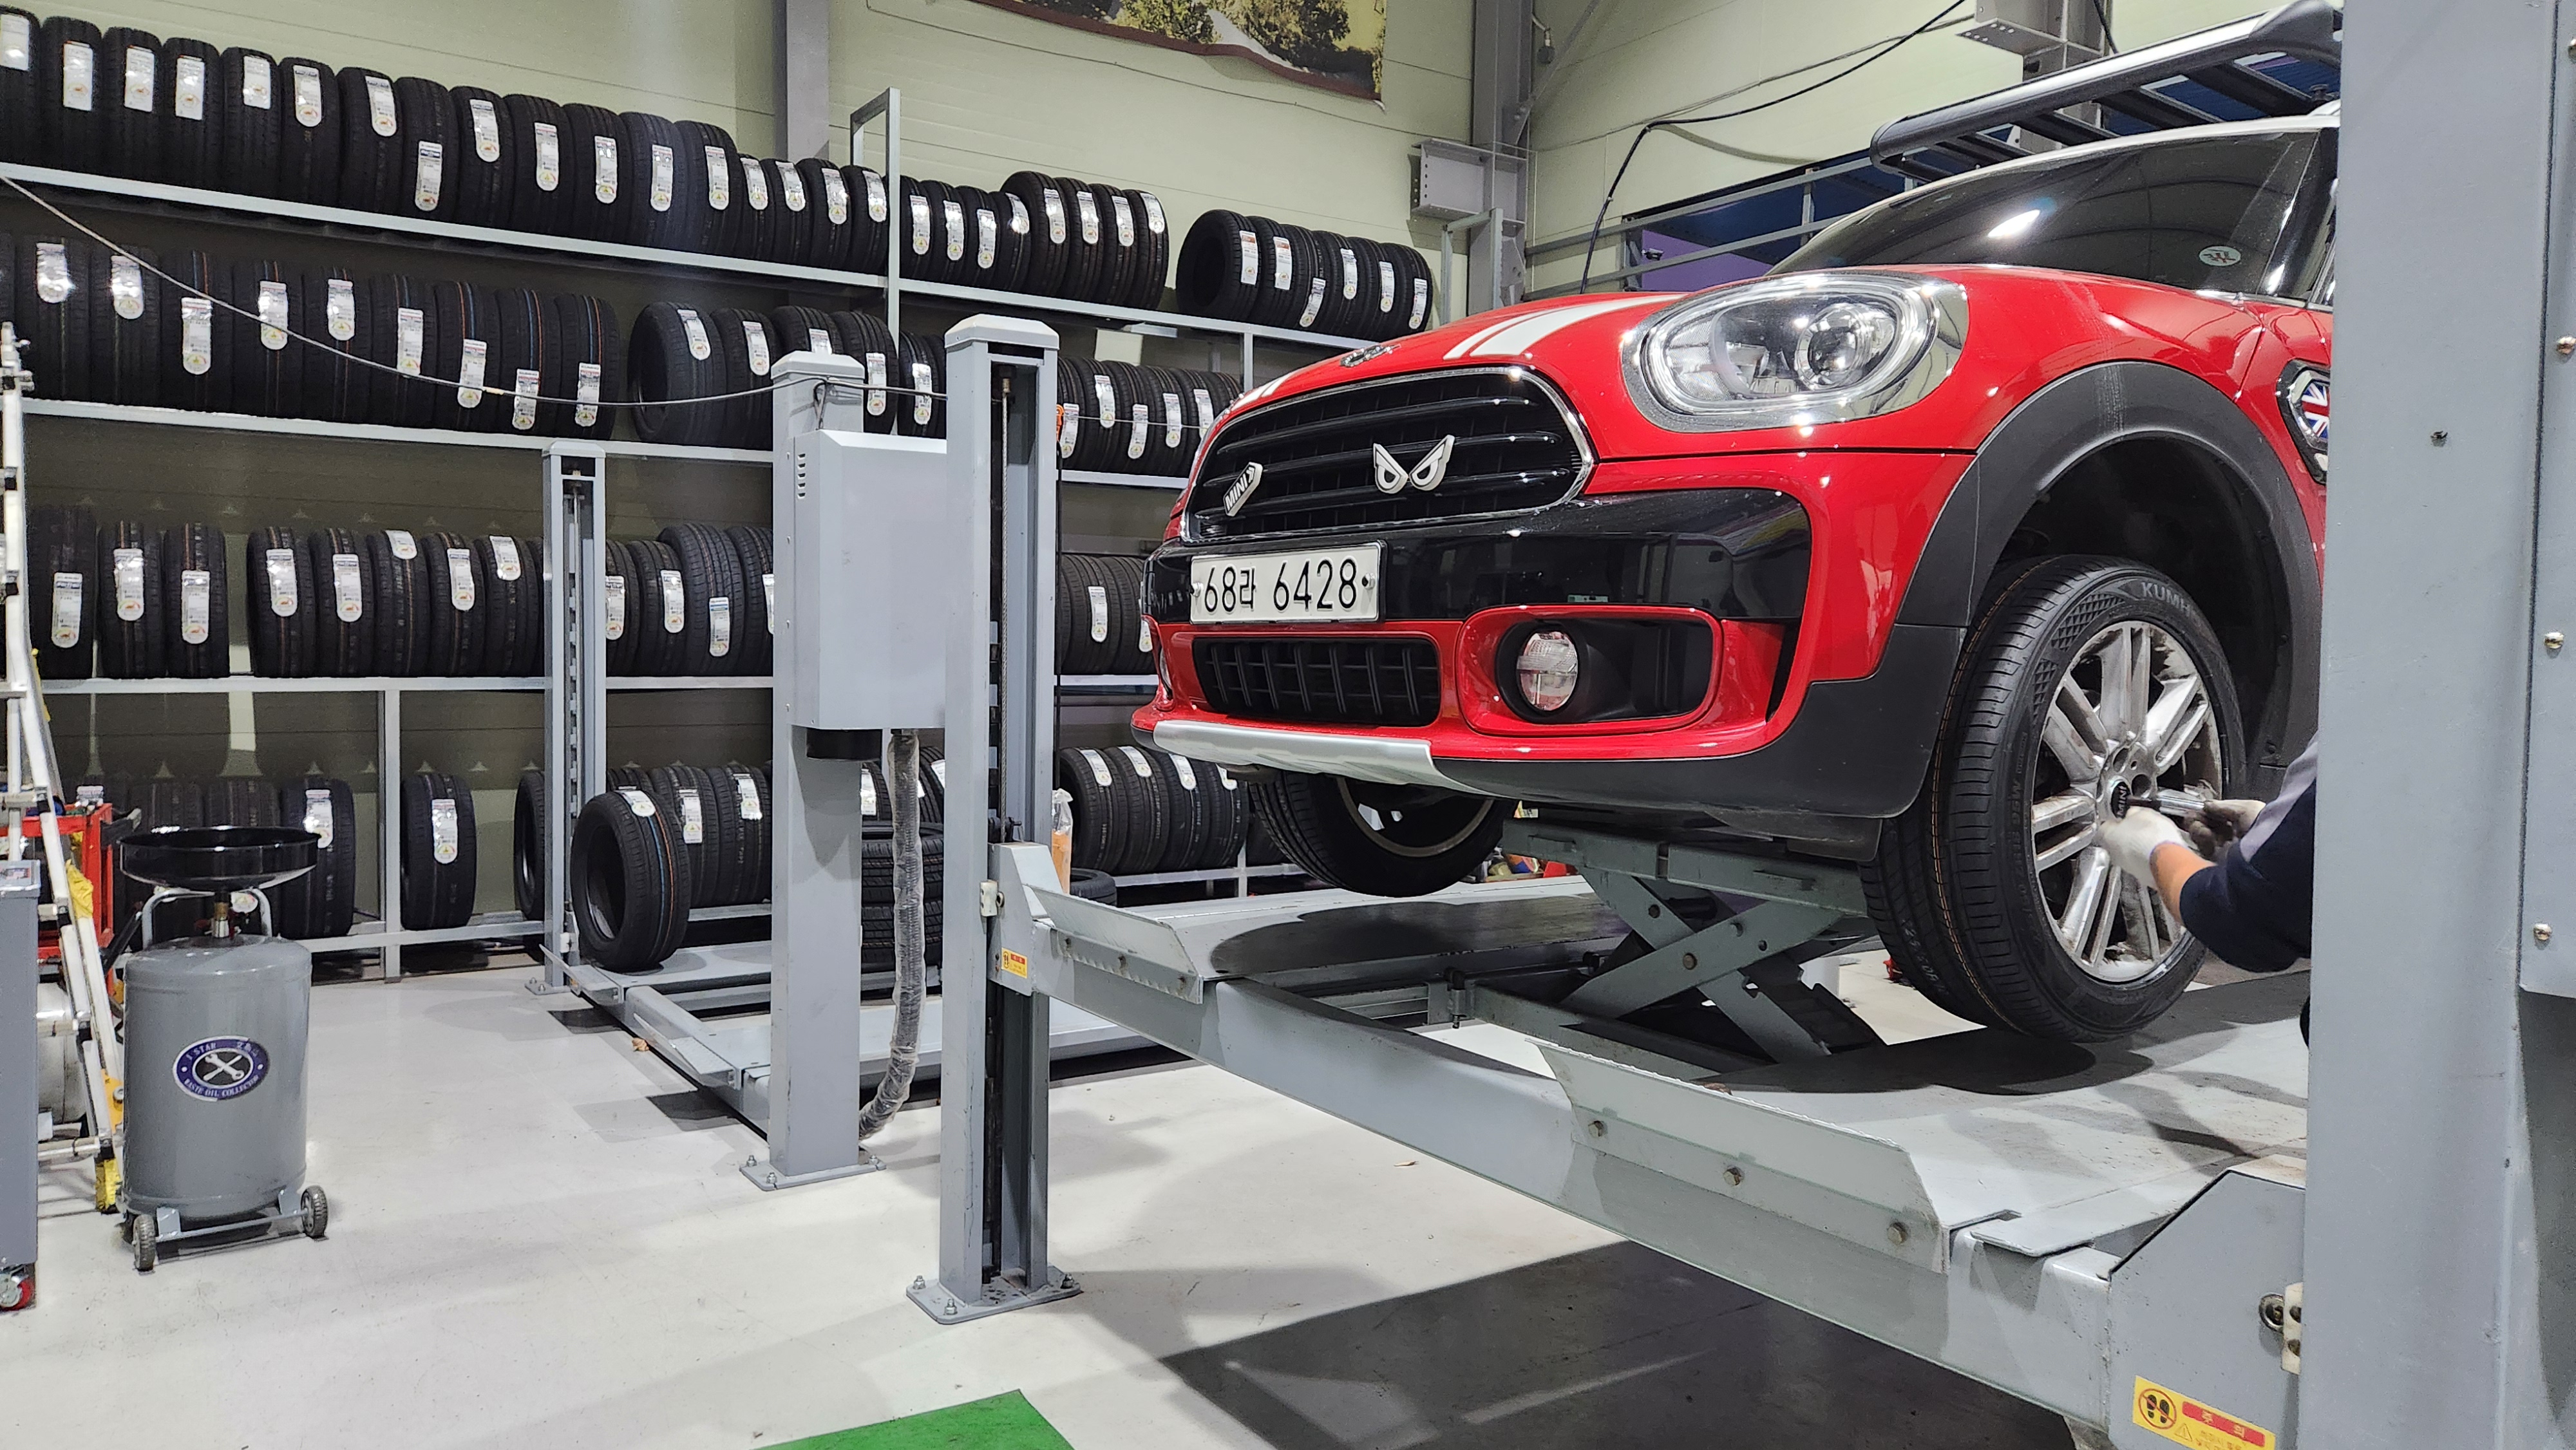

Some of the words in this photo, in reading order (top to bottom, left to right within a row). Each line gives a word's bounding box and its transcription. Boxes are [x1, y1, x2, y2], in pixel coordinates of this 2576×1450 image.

[1225, 473, 1248, 511] MINI
[1204, 566, 1256, 612] 68라
[1273, 558, 1357, 612] 6428
[2116, 785, 2127, 816] MINI
[193, 1042, 217, 1056] STAR
[204, 1089, 220, 1097] OIL
